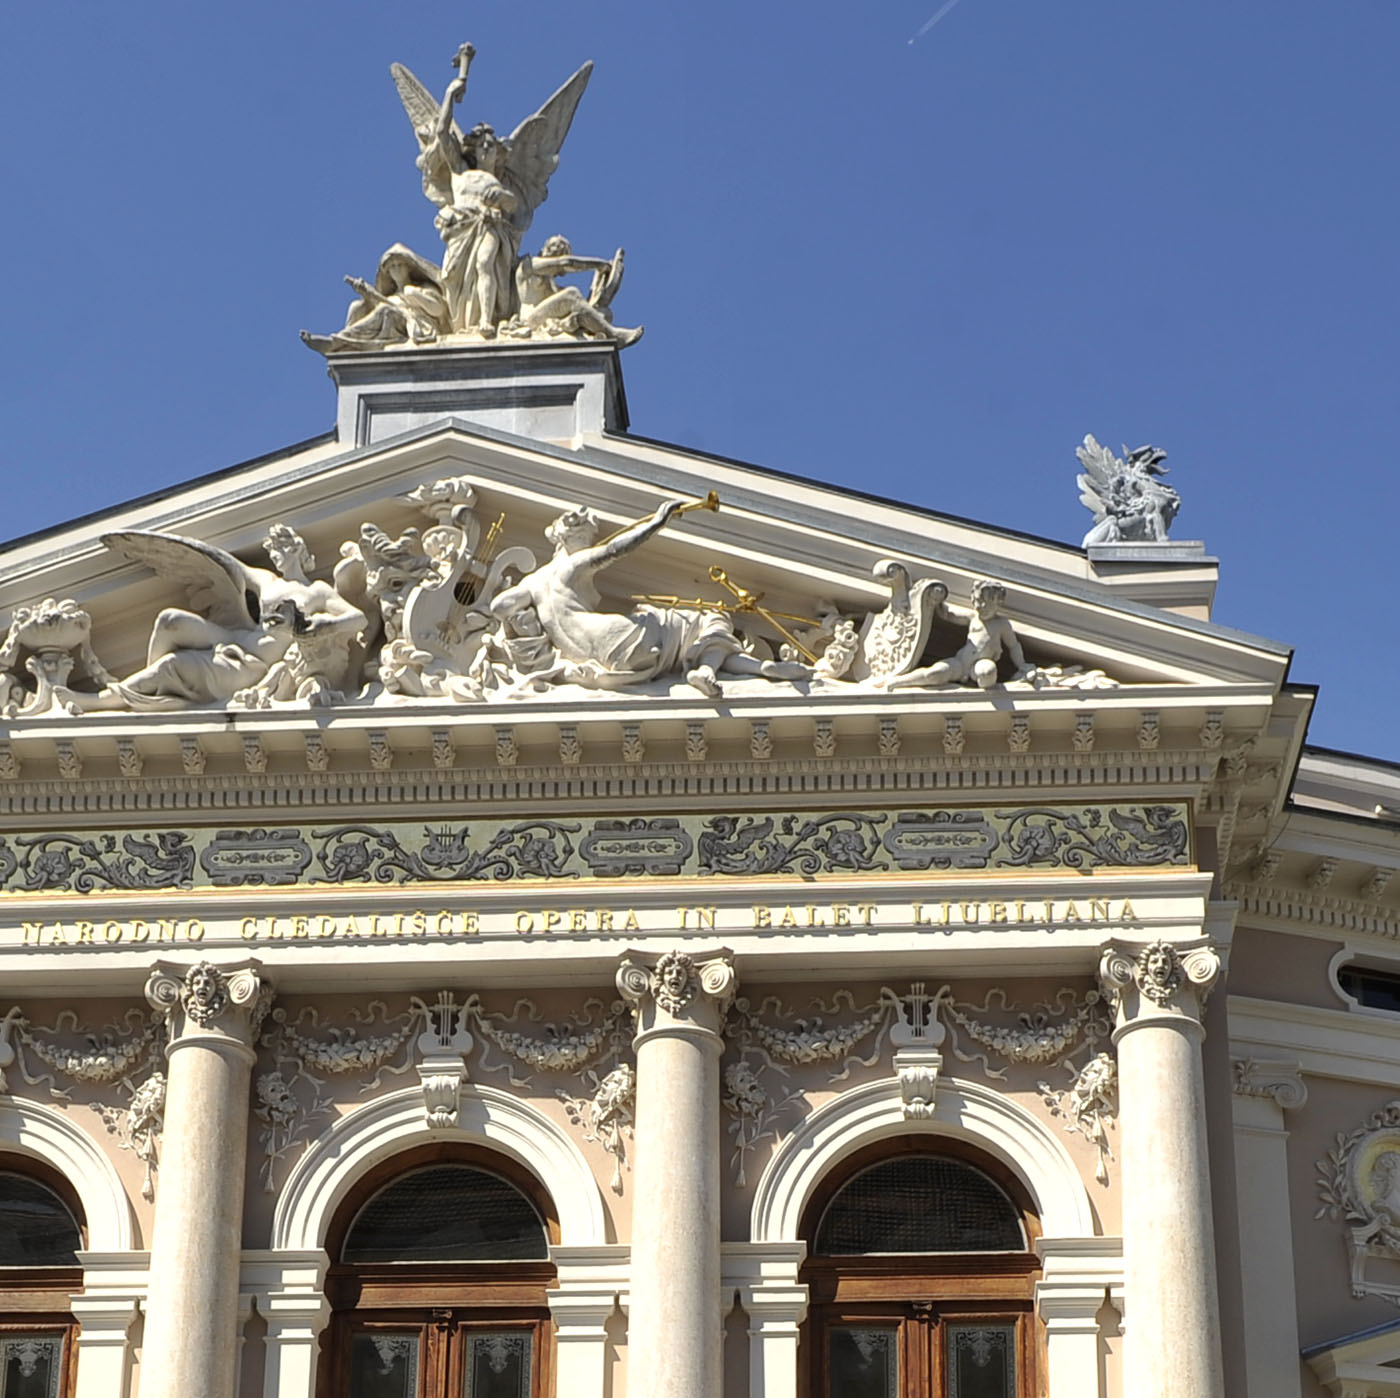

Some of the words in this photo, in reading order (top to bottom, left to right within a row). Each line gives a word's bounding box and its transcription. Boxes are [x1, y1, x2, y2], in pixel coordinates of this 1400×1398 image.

[21, 918, 206, 945] NARODNO
[240, 908, 481, 941] GLEDALIŠČE
[514, 908, 641, 935] OPERA
[676, 905, 717, 931] IN
[752, 904, 879, 928] BALET
[912, 897, 1140, 925] LJUBLJANA
